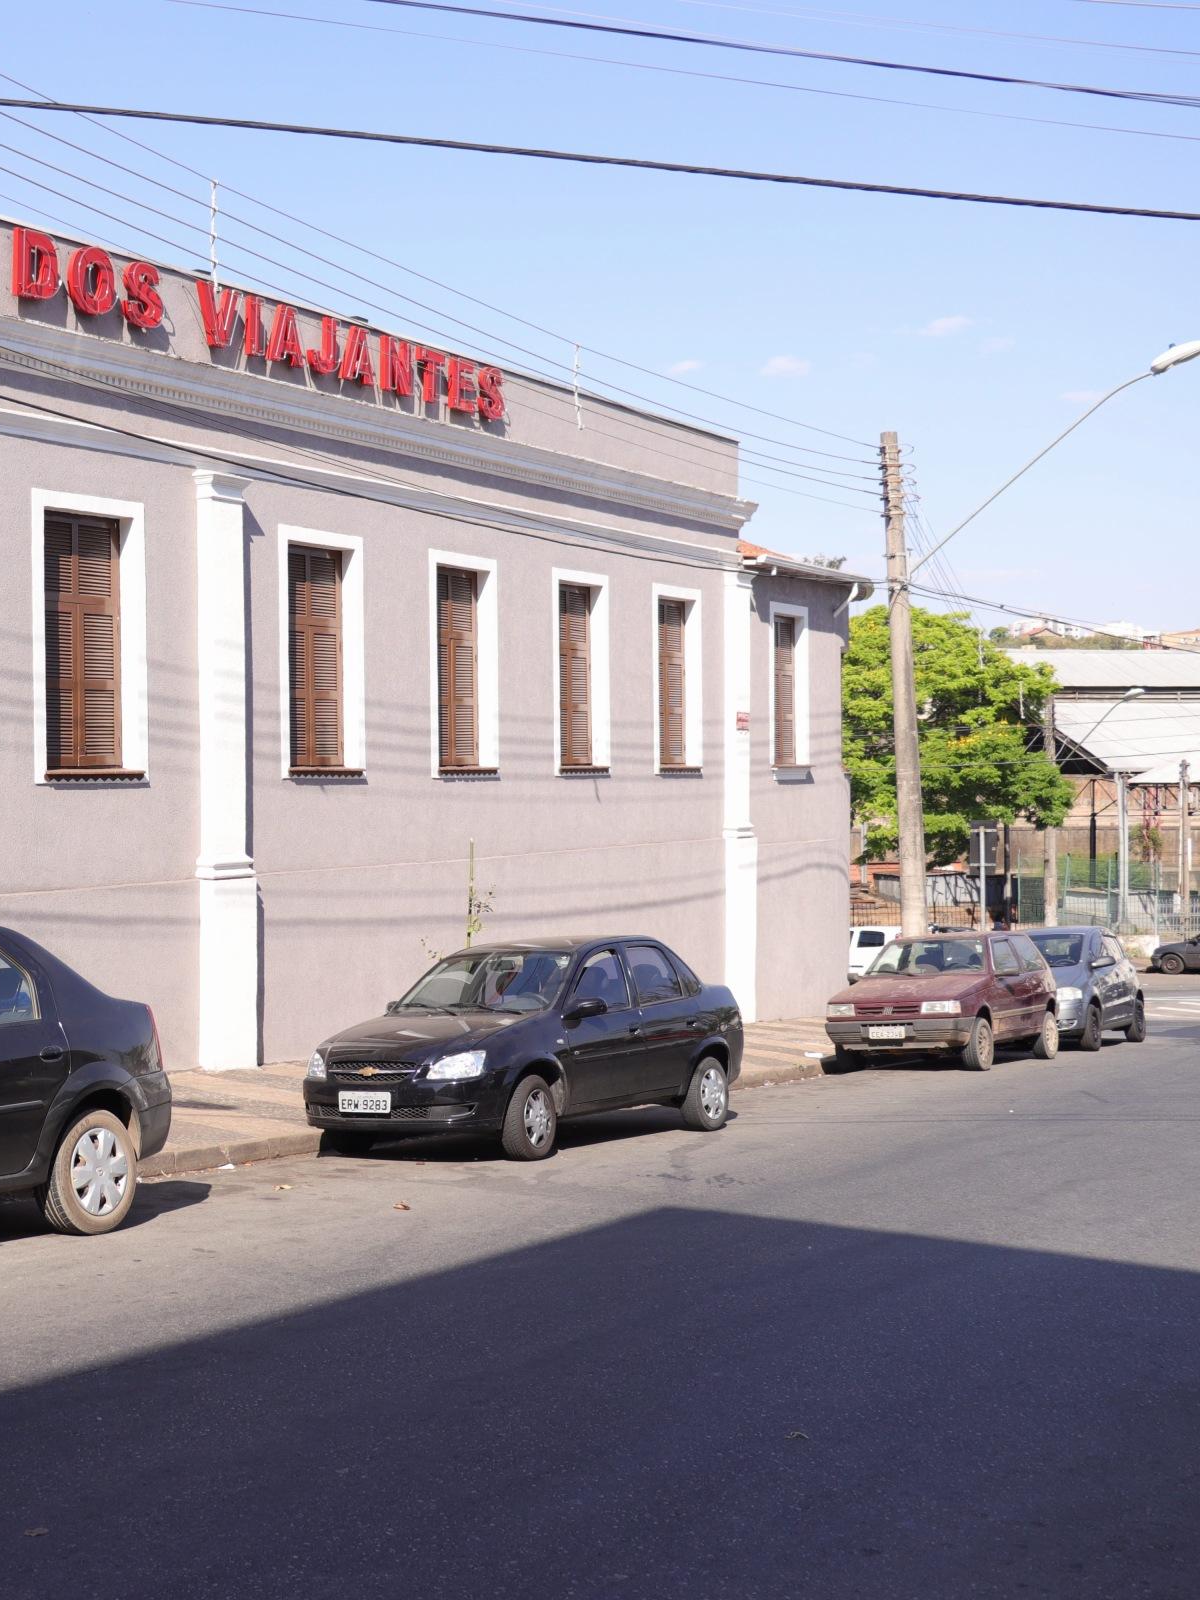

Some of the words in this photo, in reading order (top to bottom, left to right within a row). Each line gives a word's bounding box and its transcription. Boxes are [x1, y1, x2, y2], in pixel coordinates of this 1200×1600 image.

[12, 226, 164, 328] DOS
[196, 280, 506, 421] VIAJANTES
[341, 1099, 359, 1110] ERW
[362, 1099, 388, 1111] 9283
